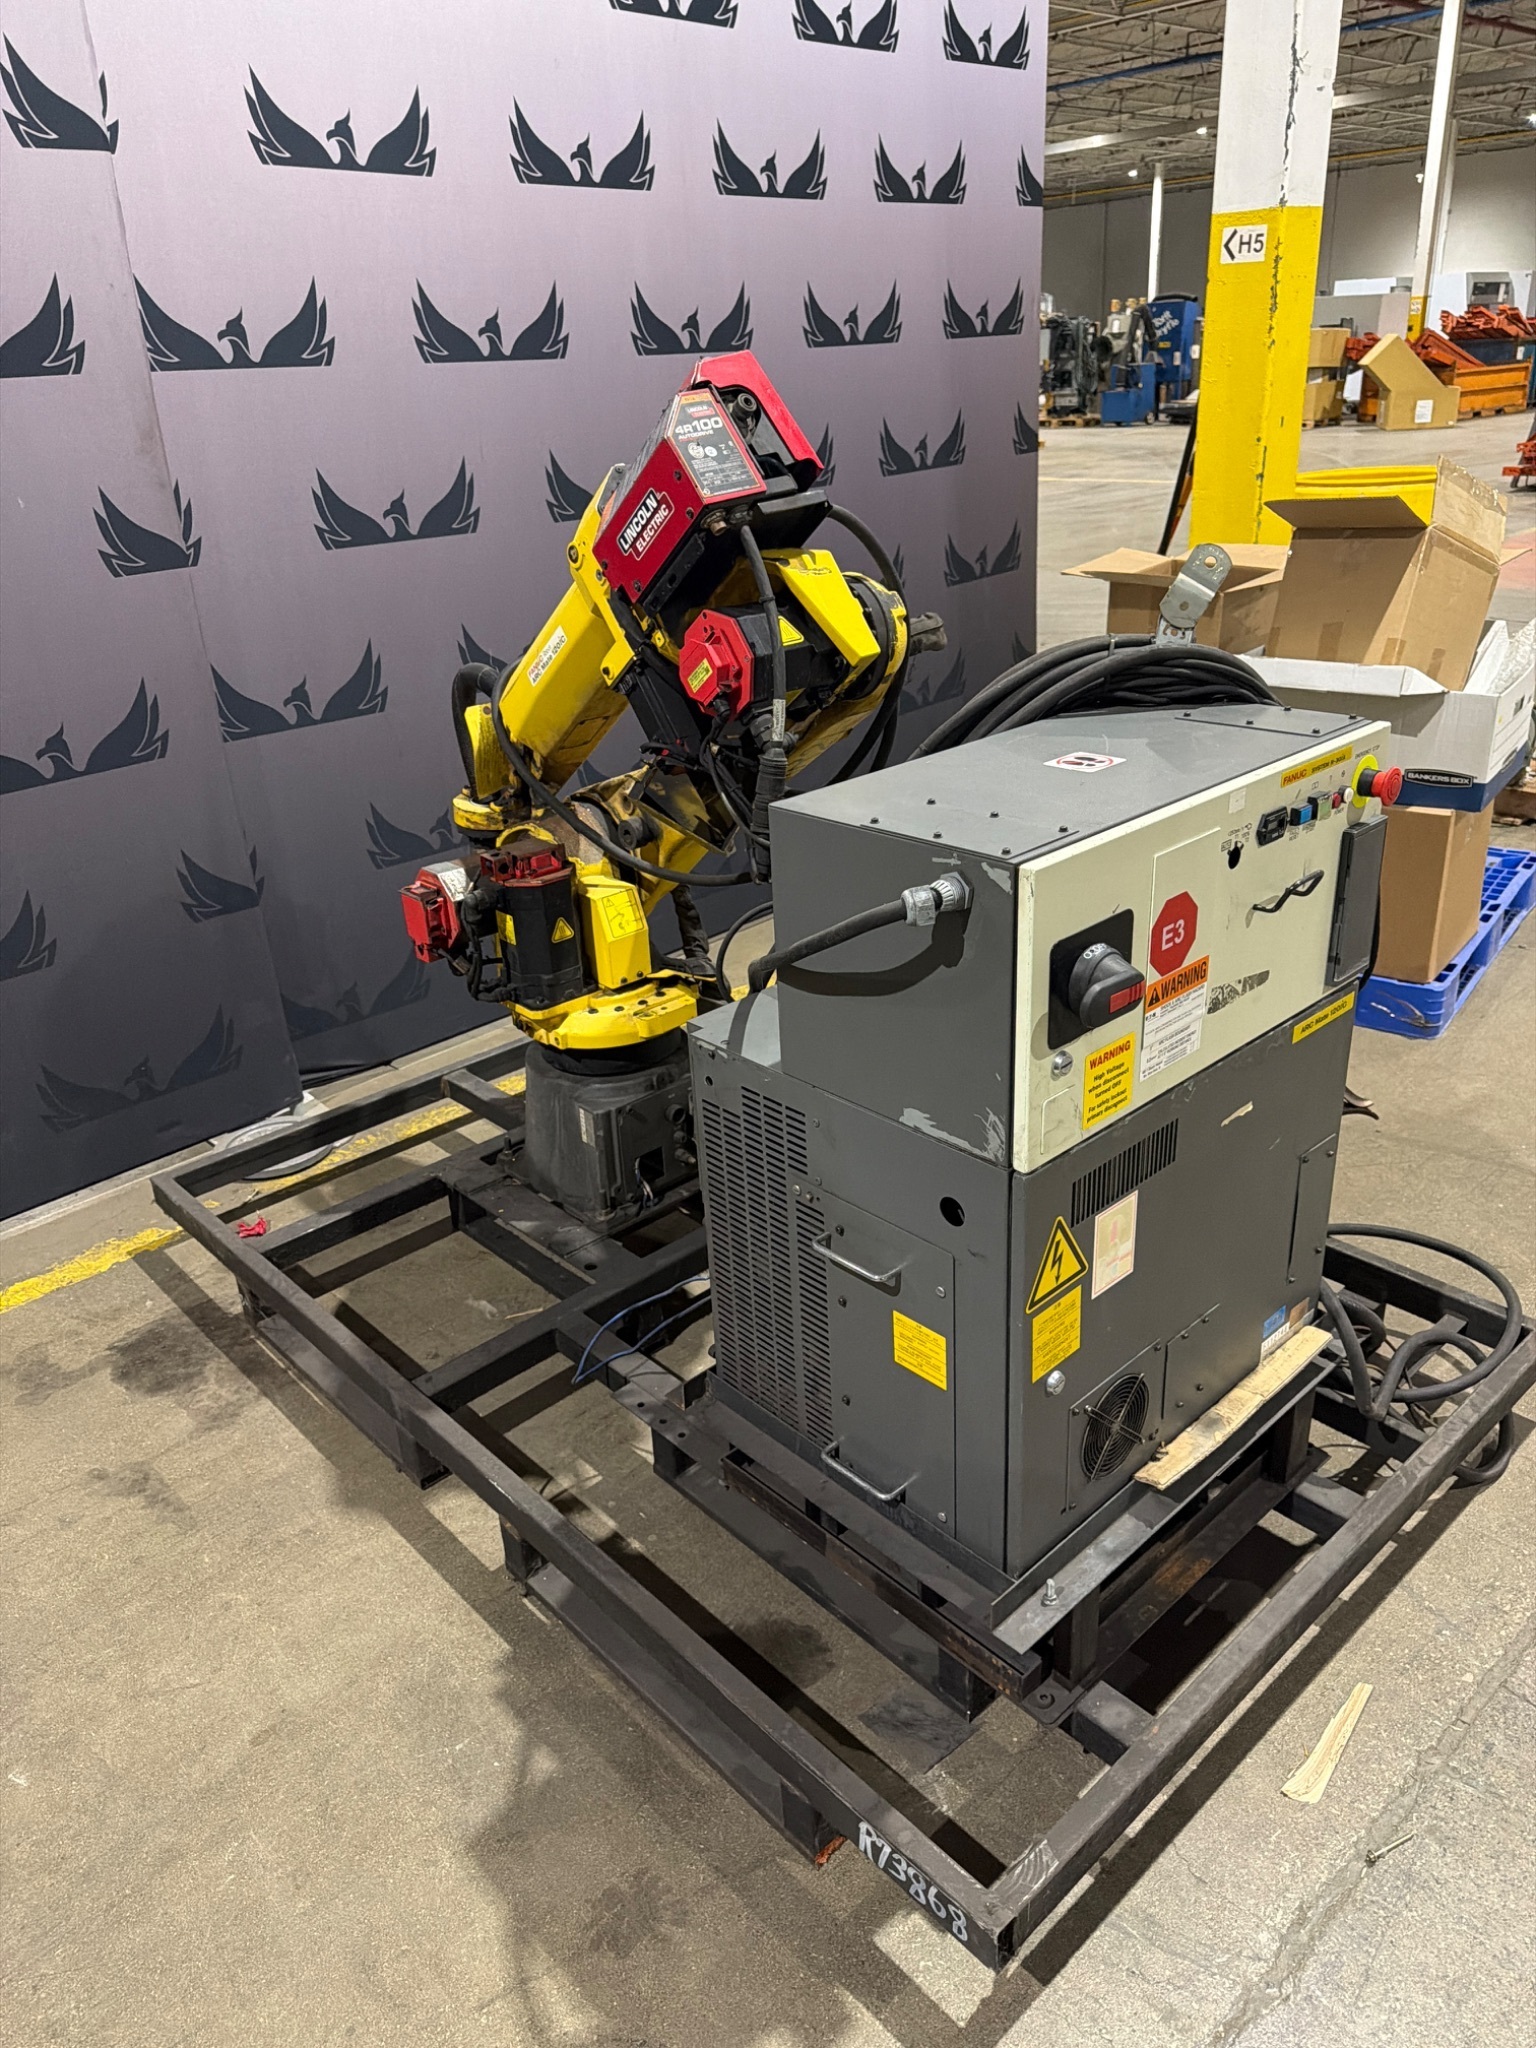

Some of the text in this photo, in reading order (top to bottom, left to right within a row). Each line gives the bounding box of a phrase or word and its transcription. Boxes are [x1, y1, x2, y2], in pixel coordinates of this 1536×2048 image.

[1238, 233, 1265, 254] H5
[675, 416, 723, 434] 4R100
[678, 429, 715, 440] AUTODRIVE
[620, 494, 658, 551] LINCOLN
[635, 504, 669, 552] ELECTRIC
[1283, 768, 1307, 787] FANUC
[1311, 761, 1330, 774] SYSTEM
[1407, 772, 1470, 785] BANKERS BOX
[1161, 918, 1185, 951] E3
[1160, 961, 1207, 1000] WARNING
[1089, 1040, 1131, 1070] WARNING
[1088, 1083, 1102, 1094] when
[1102, 1067, 1130, 1086] disconnect
[1093, 1062, 1125, 1082] High Voltage
[1094, 1079, 1122, 1099] turned OFF
[1096, 1098, 1110, 1109] safety
[1110, 1088, 1127, 1101] lockout
[858, 1821, 968, 1942] R73868
